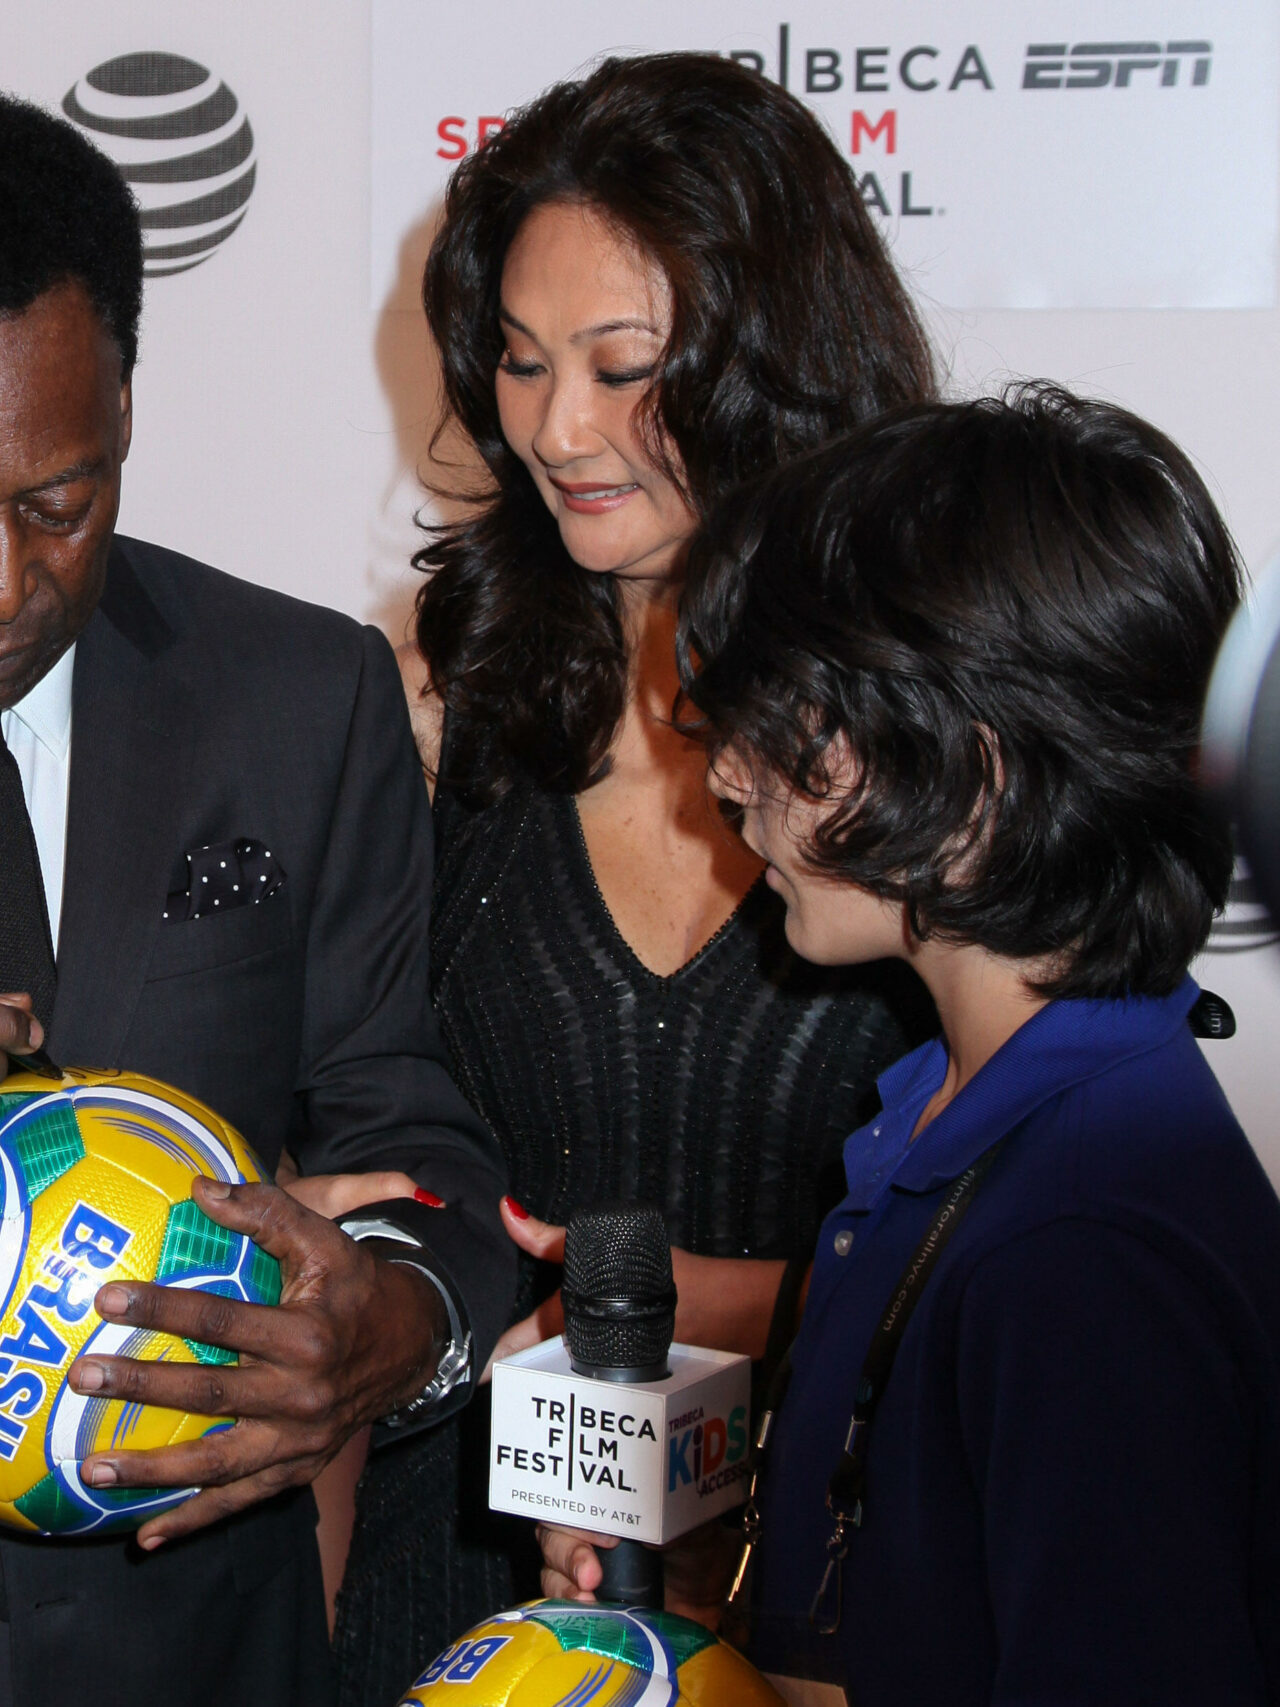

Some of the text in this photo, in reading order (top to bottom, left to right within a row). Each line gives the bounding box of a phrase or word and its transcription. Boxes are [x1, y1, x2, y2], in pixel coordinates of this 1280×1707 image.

[1022, 39, 1212, 89] ESPN
[882, 1168, 977, 1332] filmforallnyc.com
[668, 1406, 705, 1433] TRIBECA
[511, 1489, 642, 1527] PRESENTED BY AT&T
